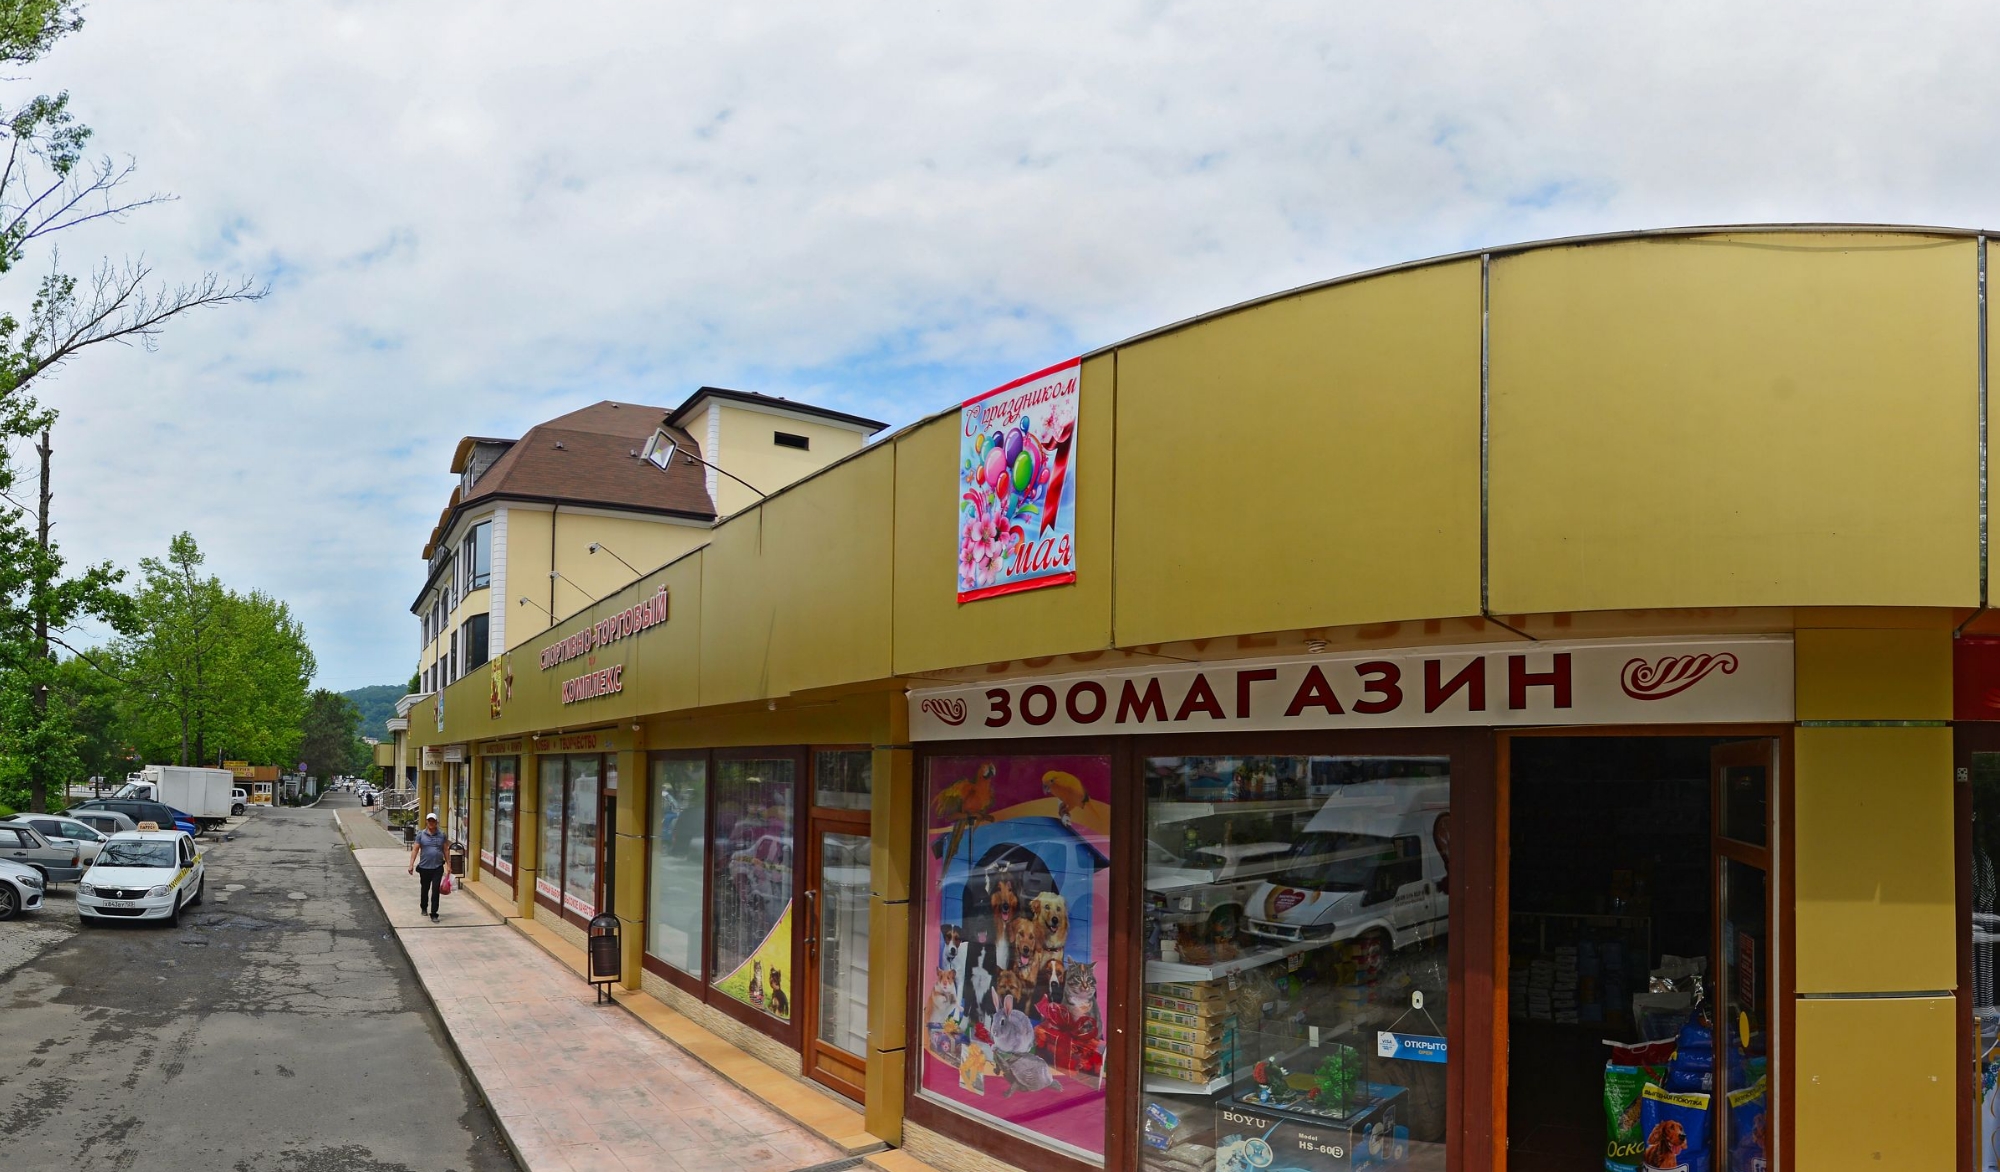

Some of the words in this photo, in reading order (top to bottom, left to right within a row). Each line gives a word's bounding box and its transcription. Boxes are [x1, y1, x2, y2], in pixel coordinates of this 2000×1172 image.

[966, 405, 981, 438] С
[981, 376, 1077, 432] праздником
[540, 584, 668, 671] СПОРТИВНО-ТОРГОВЫЙ
[562, 664, 622, 704] КОМПЛЕКС
[985, 653, 1571, 728] ЗООМАГАЗИН
[561, 735, 597, 750] ТВОРЧЕСТВО
[1404, 1040, 1447, 1051] ОТКРЫТО
[1223, 1111, 1267, 1128] BOYU
[1298, 1132, 1318, 1141] Model
